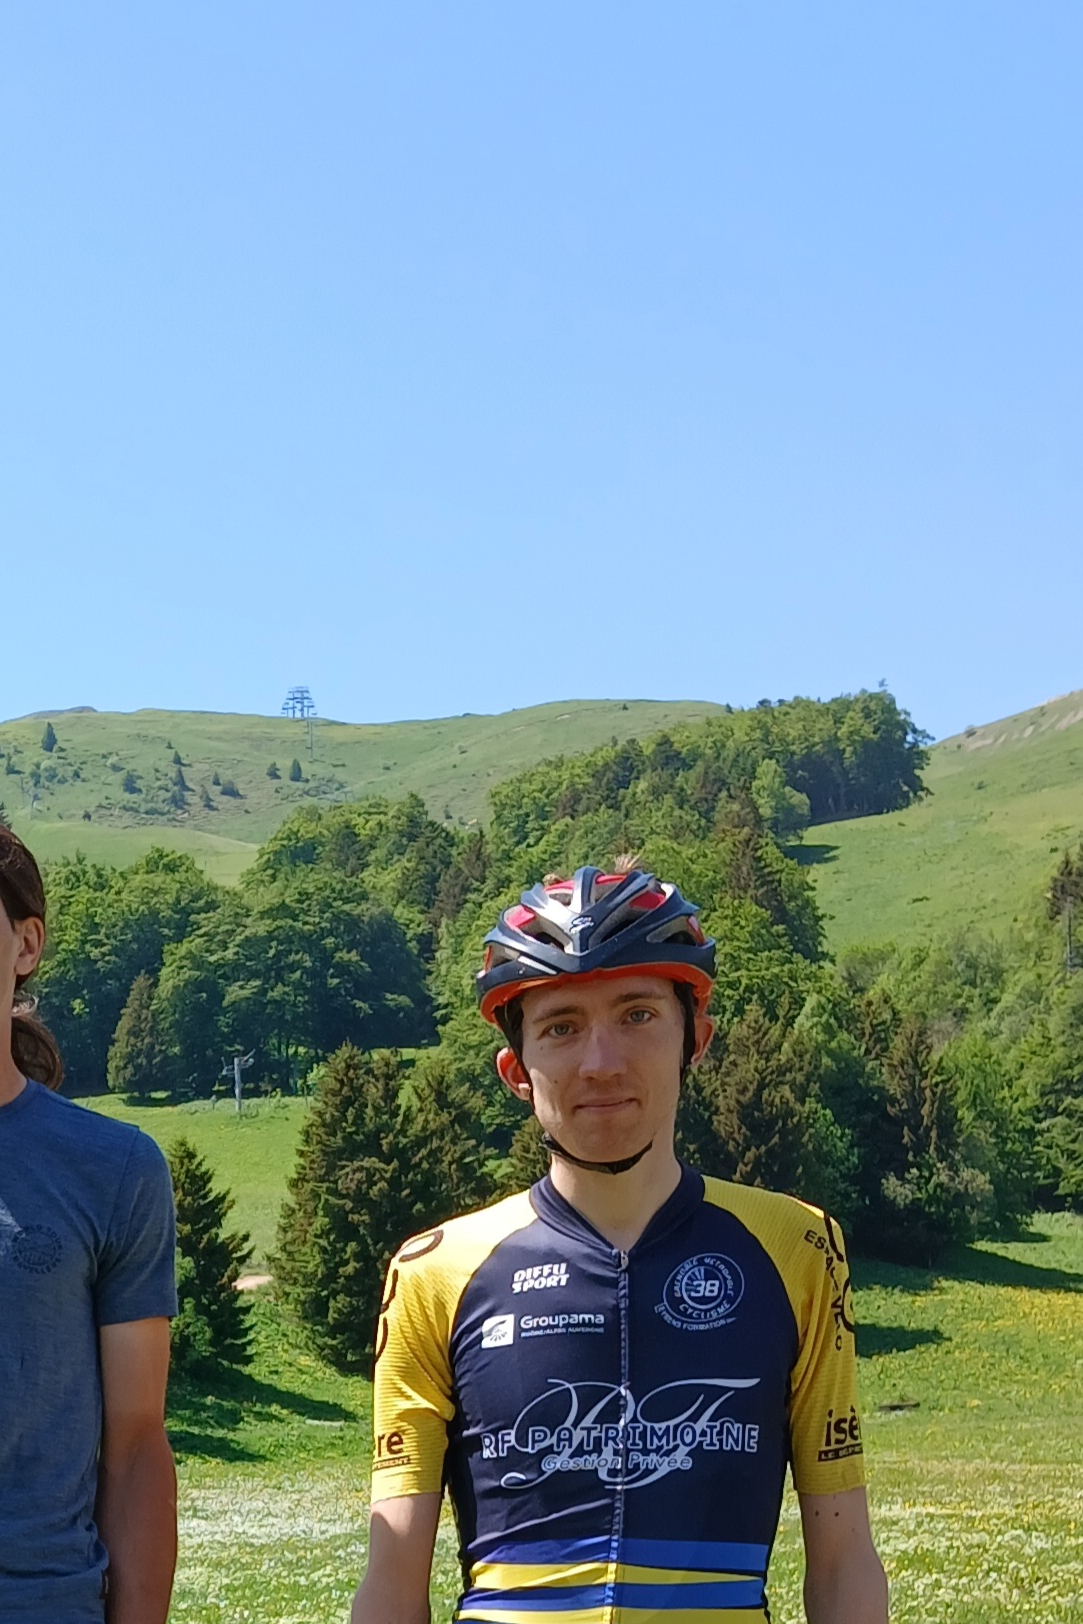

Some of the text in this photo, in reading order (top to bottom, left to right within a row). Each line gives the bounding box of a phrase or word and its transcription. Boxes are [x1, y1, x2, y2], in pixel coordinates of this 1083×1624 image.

[513, 1263, 568, 1282] DIFFU
[511, 1274, 570, 1294] SPORT
[690, 1279, 720, 1297] 38
[520, 1313, 605, 1329] Groupama
[825, 1405, 862, 1447] isè
[481, 1420, 760, 1459] RF PATRIMOINE
[541, 1450, 693, 1472] Gestion Privée
